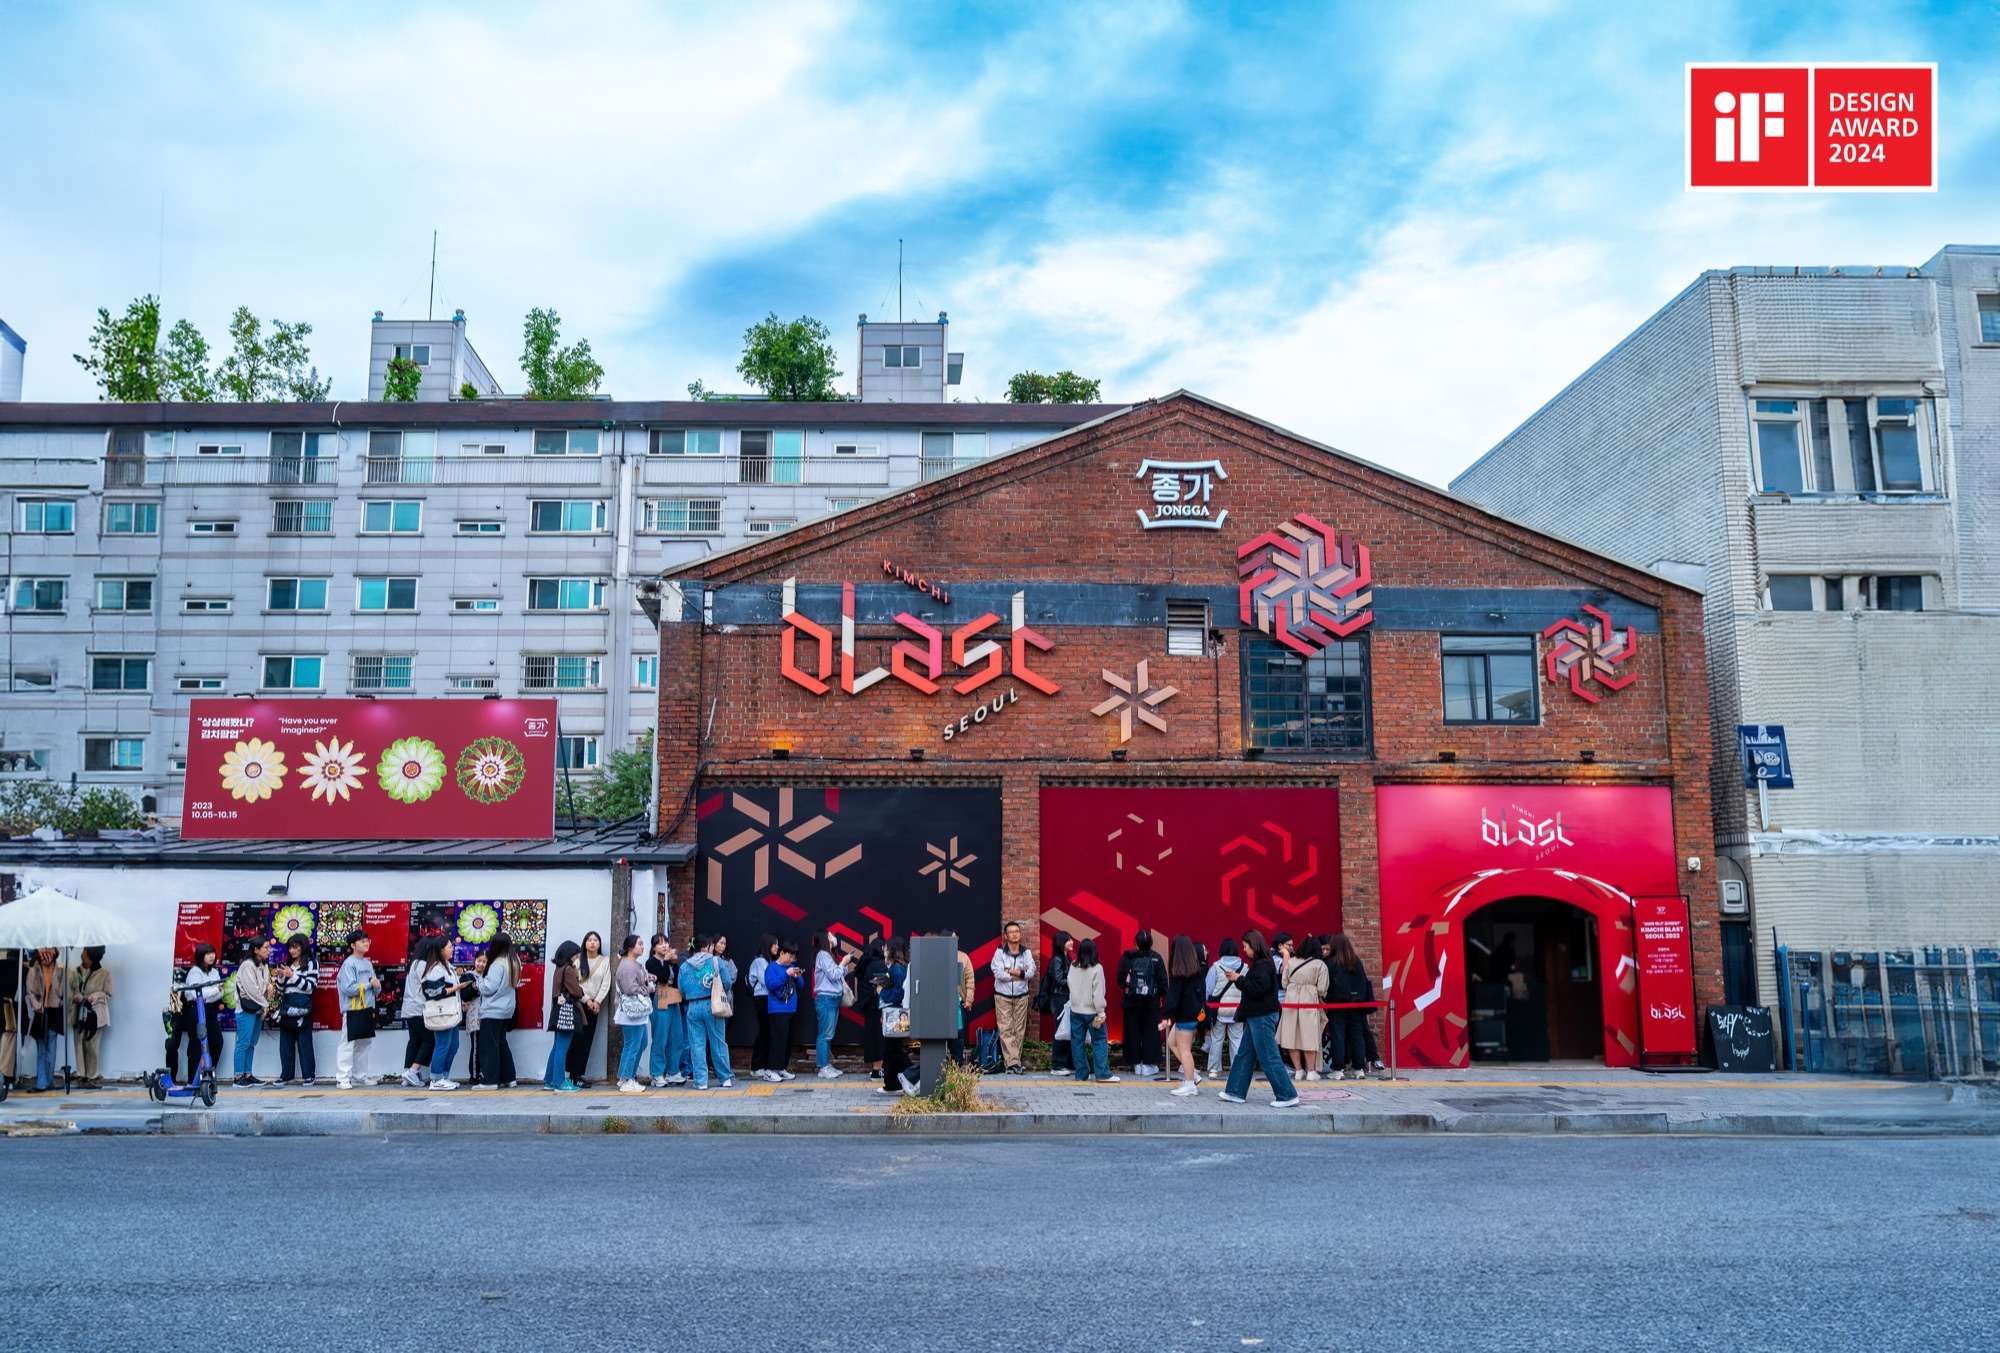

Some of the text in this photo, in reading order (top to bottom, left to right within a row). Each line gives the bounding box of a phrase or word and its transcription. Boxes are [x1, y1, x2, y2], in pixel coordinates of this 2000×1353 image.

[1151, 473, 1214, 502] 종가
[1154, 504, 1210, 518] JONGGA
[883, 559, 949, 604] KIMCHI
[303, 718, 318, 726] you
[943, 687, 1019, 741] SEOUL
[192, 802, 213, 810] 2023
[191, 811, 238, 819] 10.05-10.15
[1535, 843, 1560, 861] SEOUL
